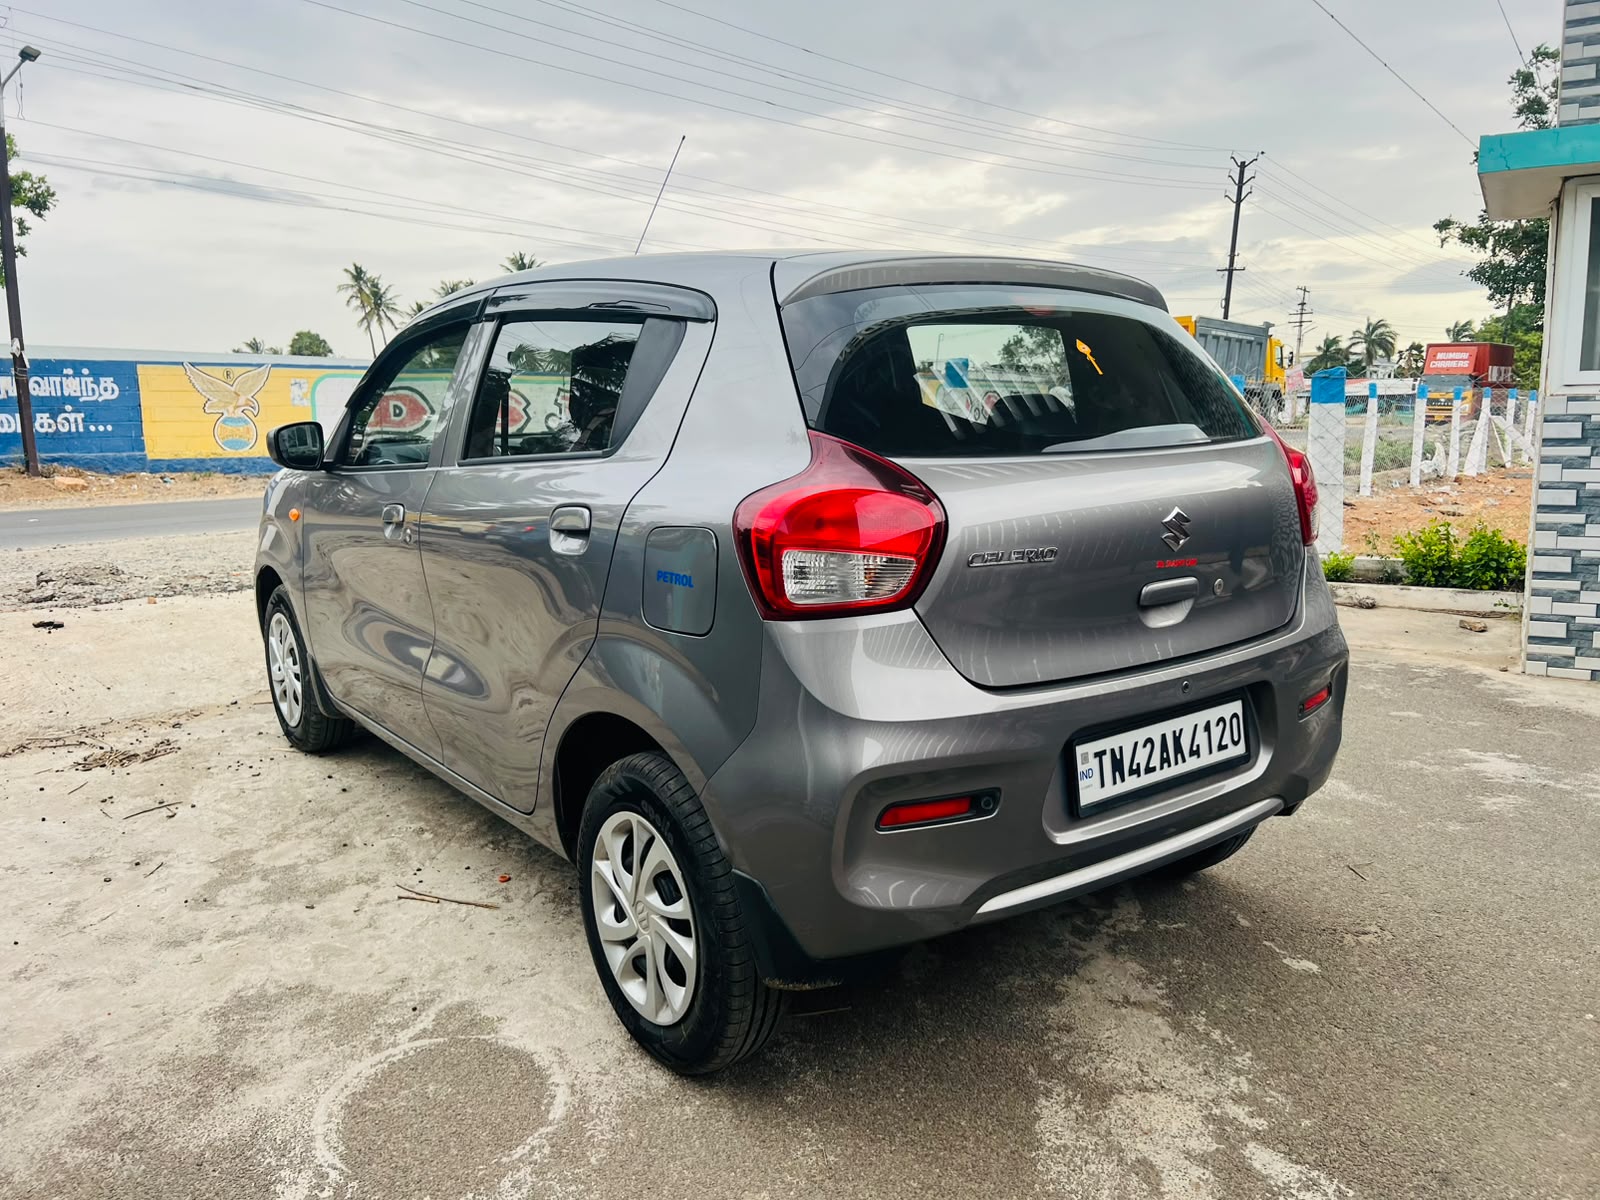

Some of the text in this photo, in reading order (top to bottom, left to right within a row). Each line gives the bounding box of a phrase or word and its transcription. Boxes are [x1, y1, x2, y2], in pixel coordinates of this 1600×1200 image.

[967, 546, 1058, 568] CELERIO
[656, 570, 694, 588] PETROL
[1094, 712, 1242, 789] TN42AK4120
[1079, 767, 1094, 782] IND
